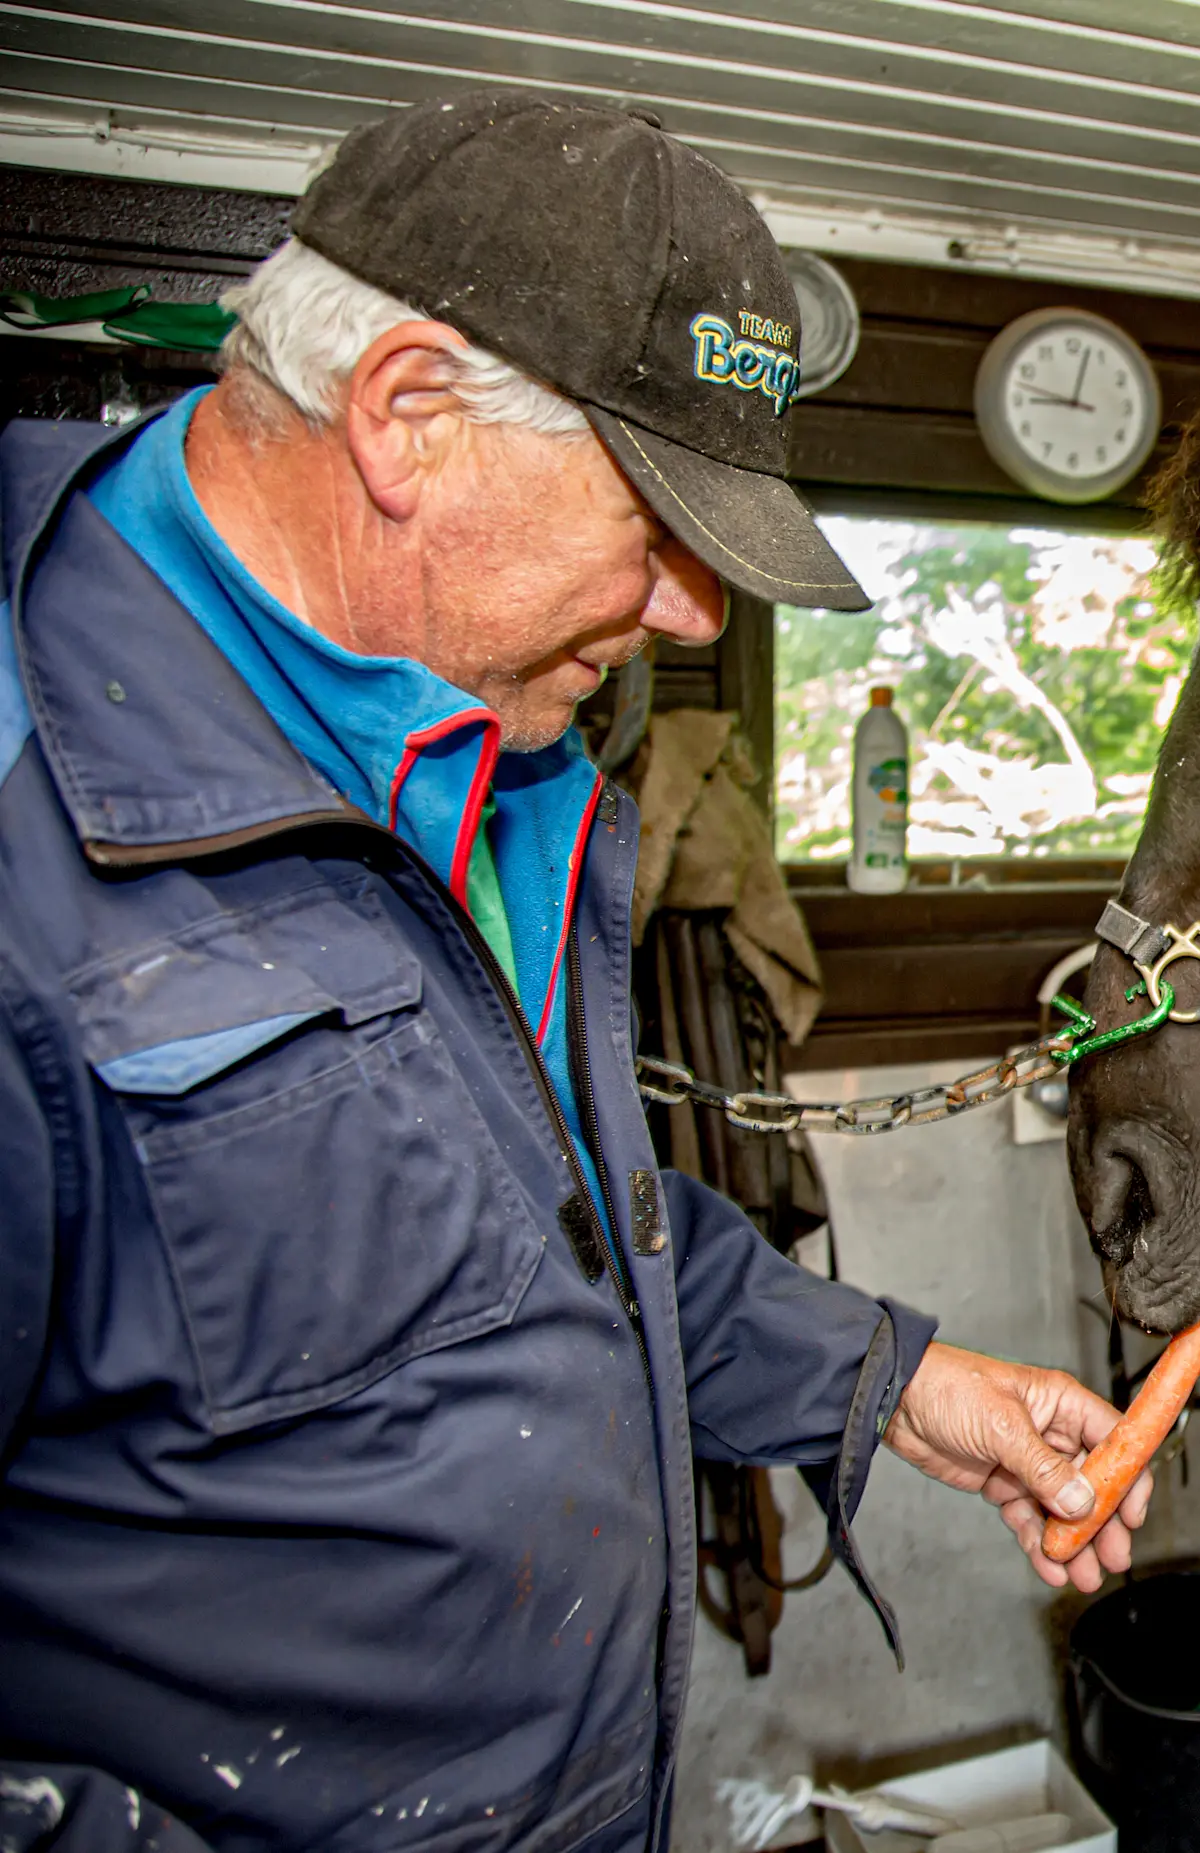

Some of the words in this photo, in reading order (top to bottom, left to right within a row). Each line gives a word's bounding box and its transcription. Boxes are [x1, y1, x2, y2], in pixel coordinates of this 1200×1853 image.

[738, 310, 792, 347] TEAM
[1040, 346, 1054, 360] 11
[1066, 338, 1080, 355] 12
[1097, 349, 1106, 364] 1
[1021, 362, 1036, 380] 10
[1115, 370, 1127, 388] 2
[1012, 393, 1023, 408] 9
[1123, 399, 1133, 416] 3
[1114, 428, 1126, 444] 4
[1042, 442, 1054, 457] 7
[1096, 445, 1107, 462] 5
[1066, 452, 1079, 469] 6
